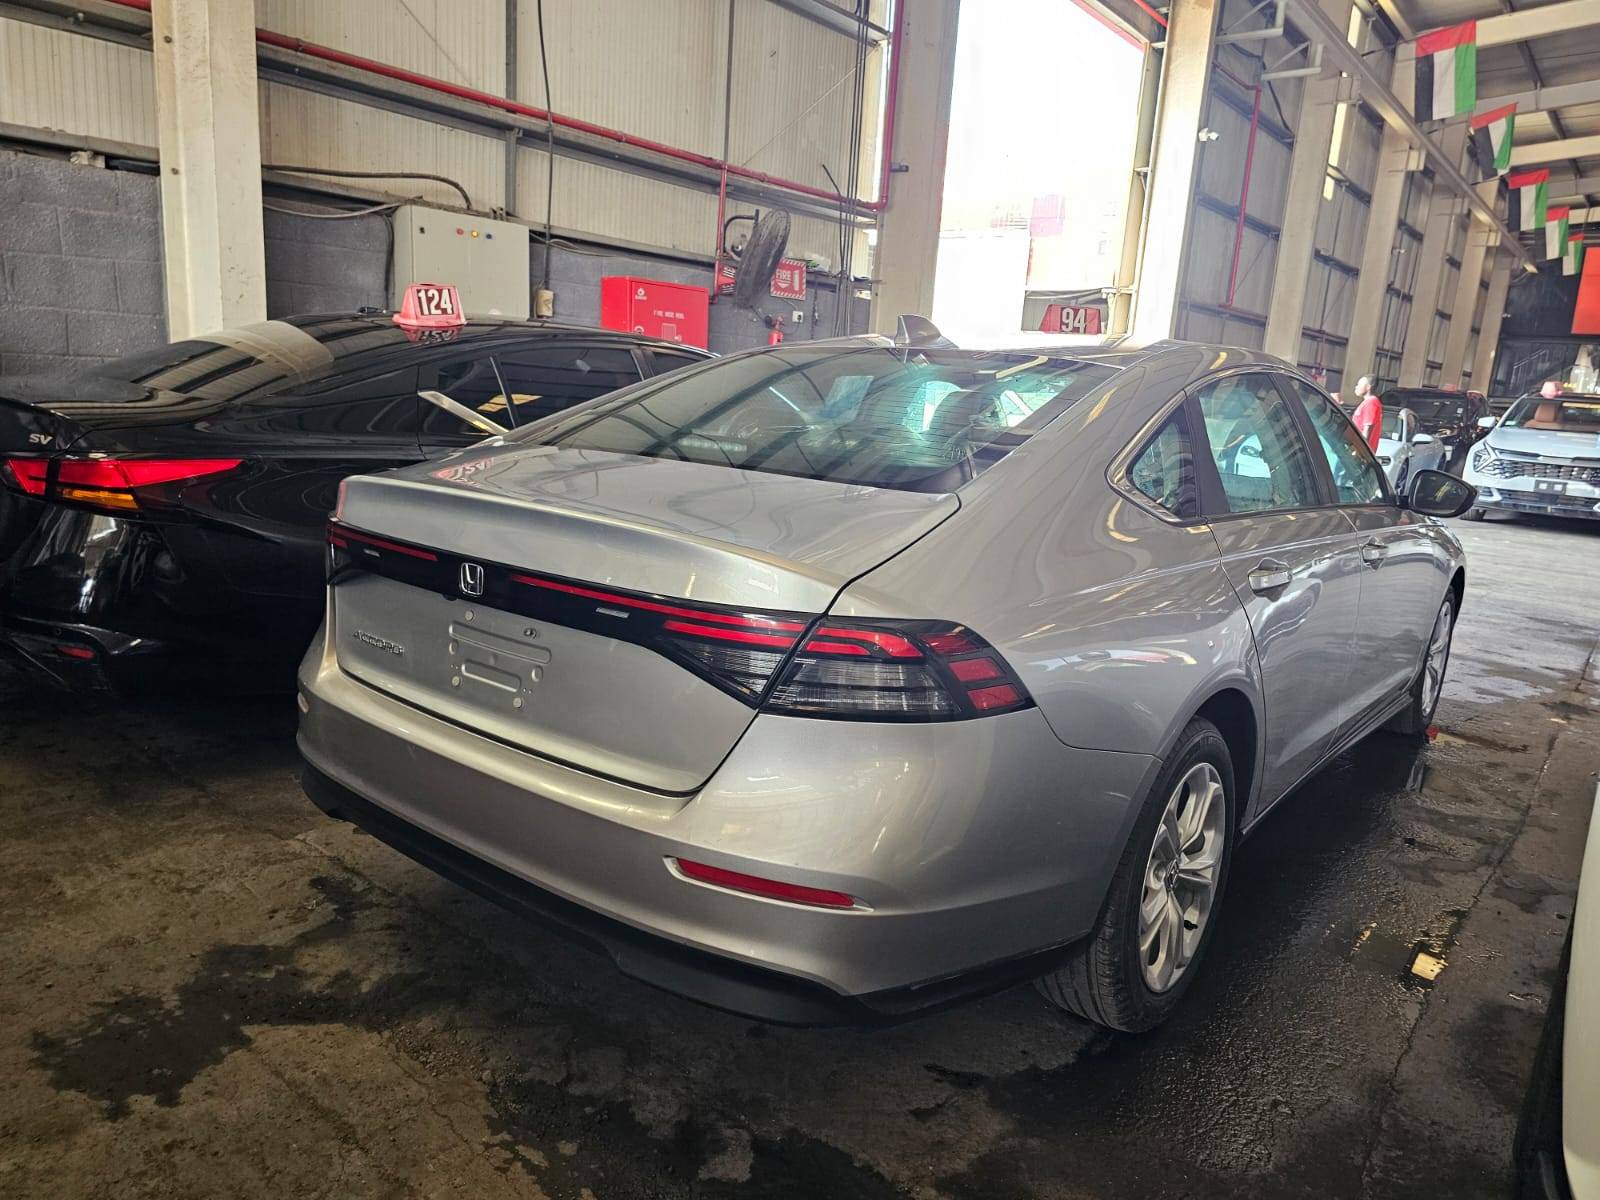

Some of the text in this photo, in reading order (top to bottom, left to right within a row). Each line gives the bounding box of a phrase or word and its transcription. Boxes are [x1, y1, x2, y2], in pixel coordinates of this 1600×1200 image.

[776, 268, 792, 281] FIRE
[418, 289, 453, 315] 124
[1061, 307, 1087, 334] 94
[29, 433, 53, 444] SV
